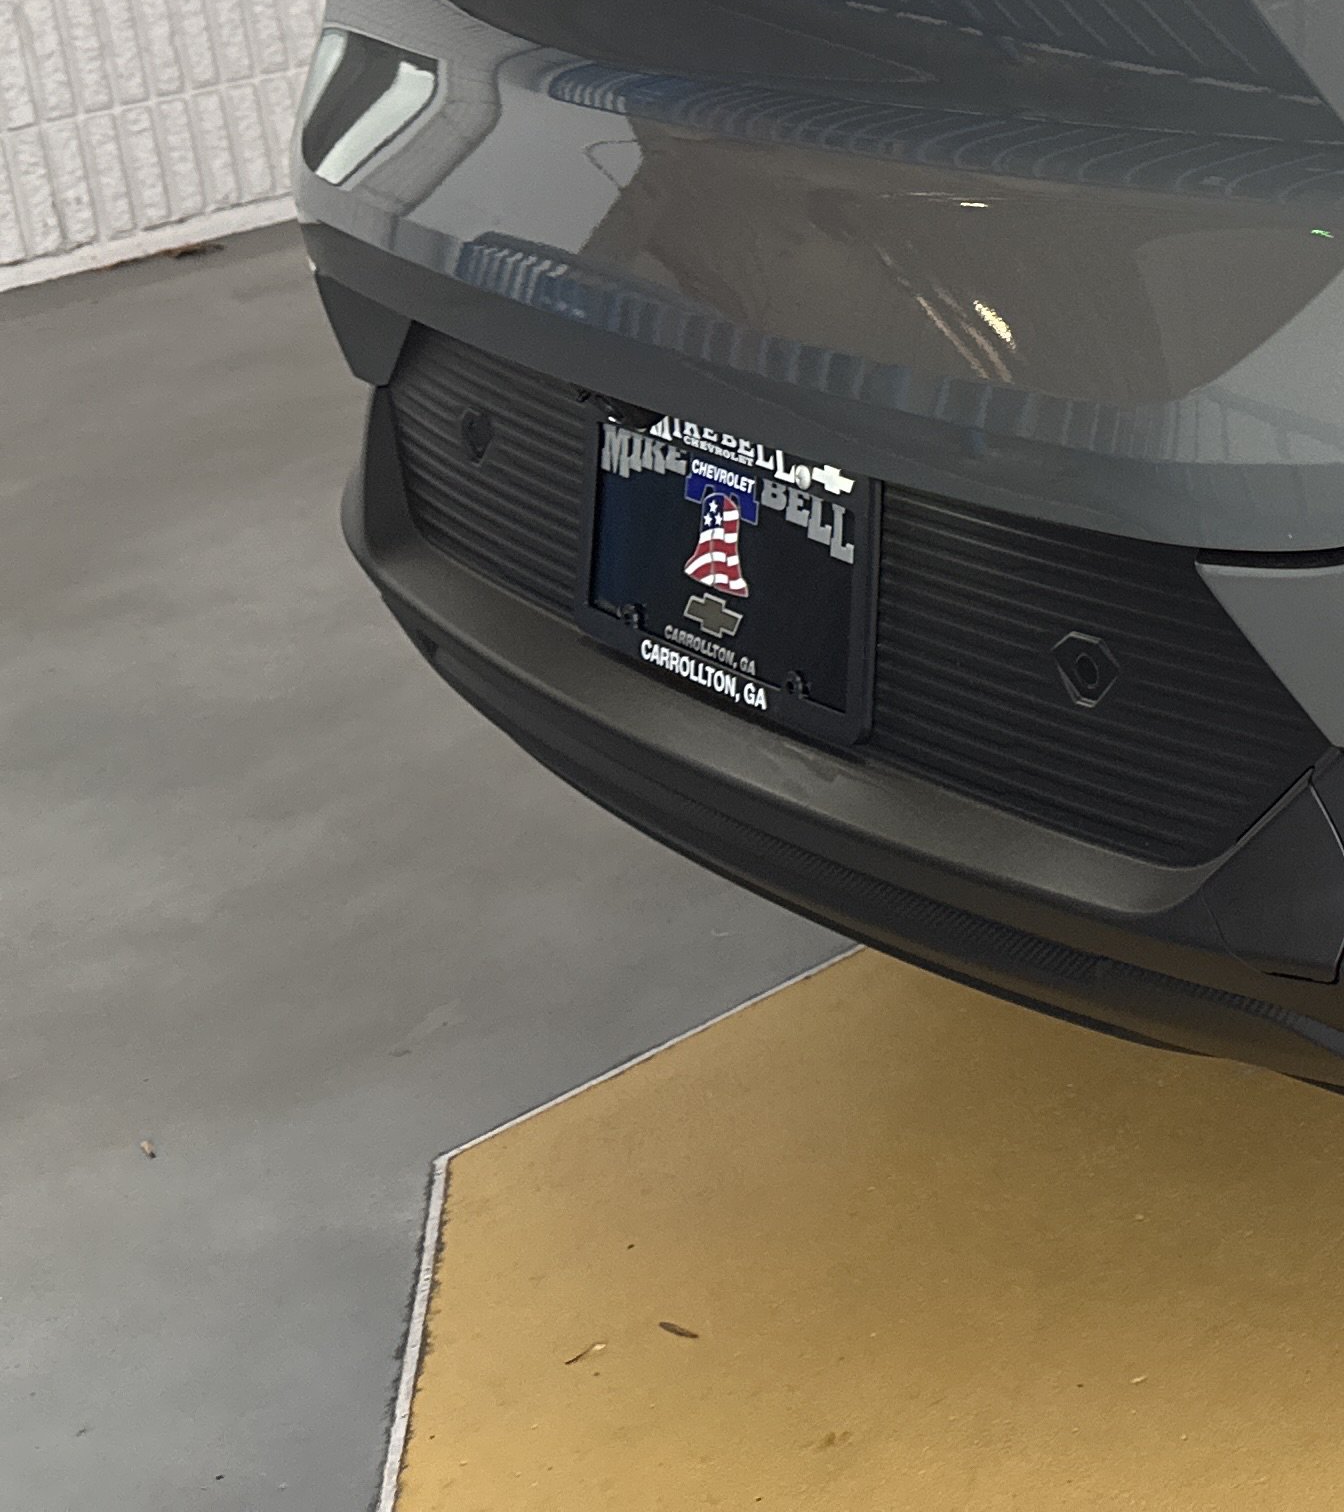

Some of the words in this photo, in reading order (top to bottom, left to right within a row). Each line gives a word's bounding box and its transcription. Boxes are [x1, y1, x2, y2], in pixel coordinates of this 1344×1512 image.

[683, 435, 755, 468] CHEVROLET
[691, 458, 755, 494] CHEVROLET
[601, 424, 687, 478] MIKE
[761, 478, 854, 565] BELL
[641, 638, 740, 703] CARROLLTON,
[743, 682, 767, 711] GA
[664, 624, 738, 669] CARROLLTON,
[741, 656, 756, 676] GA
